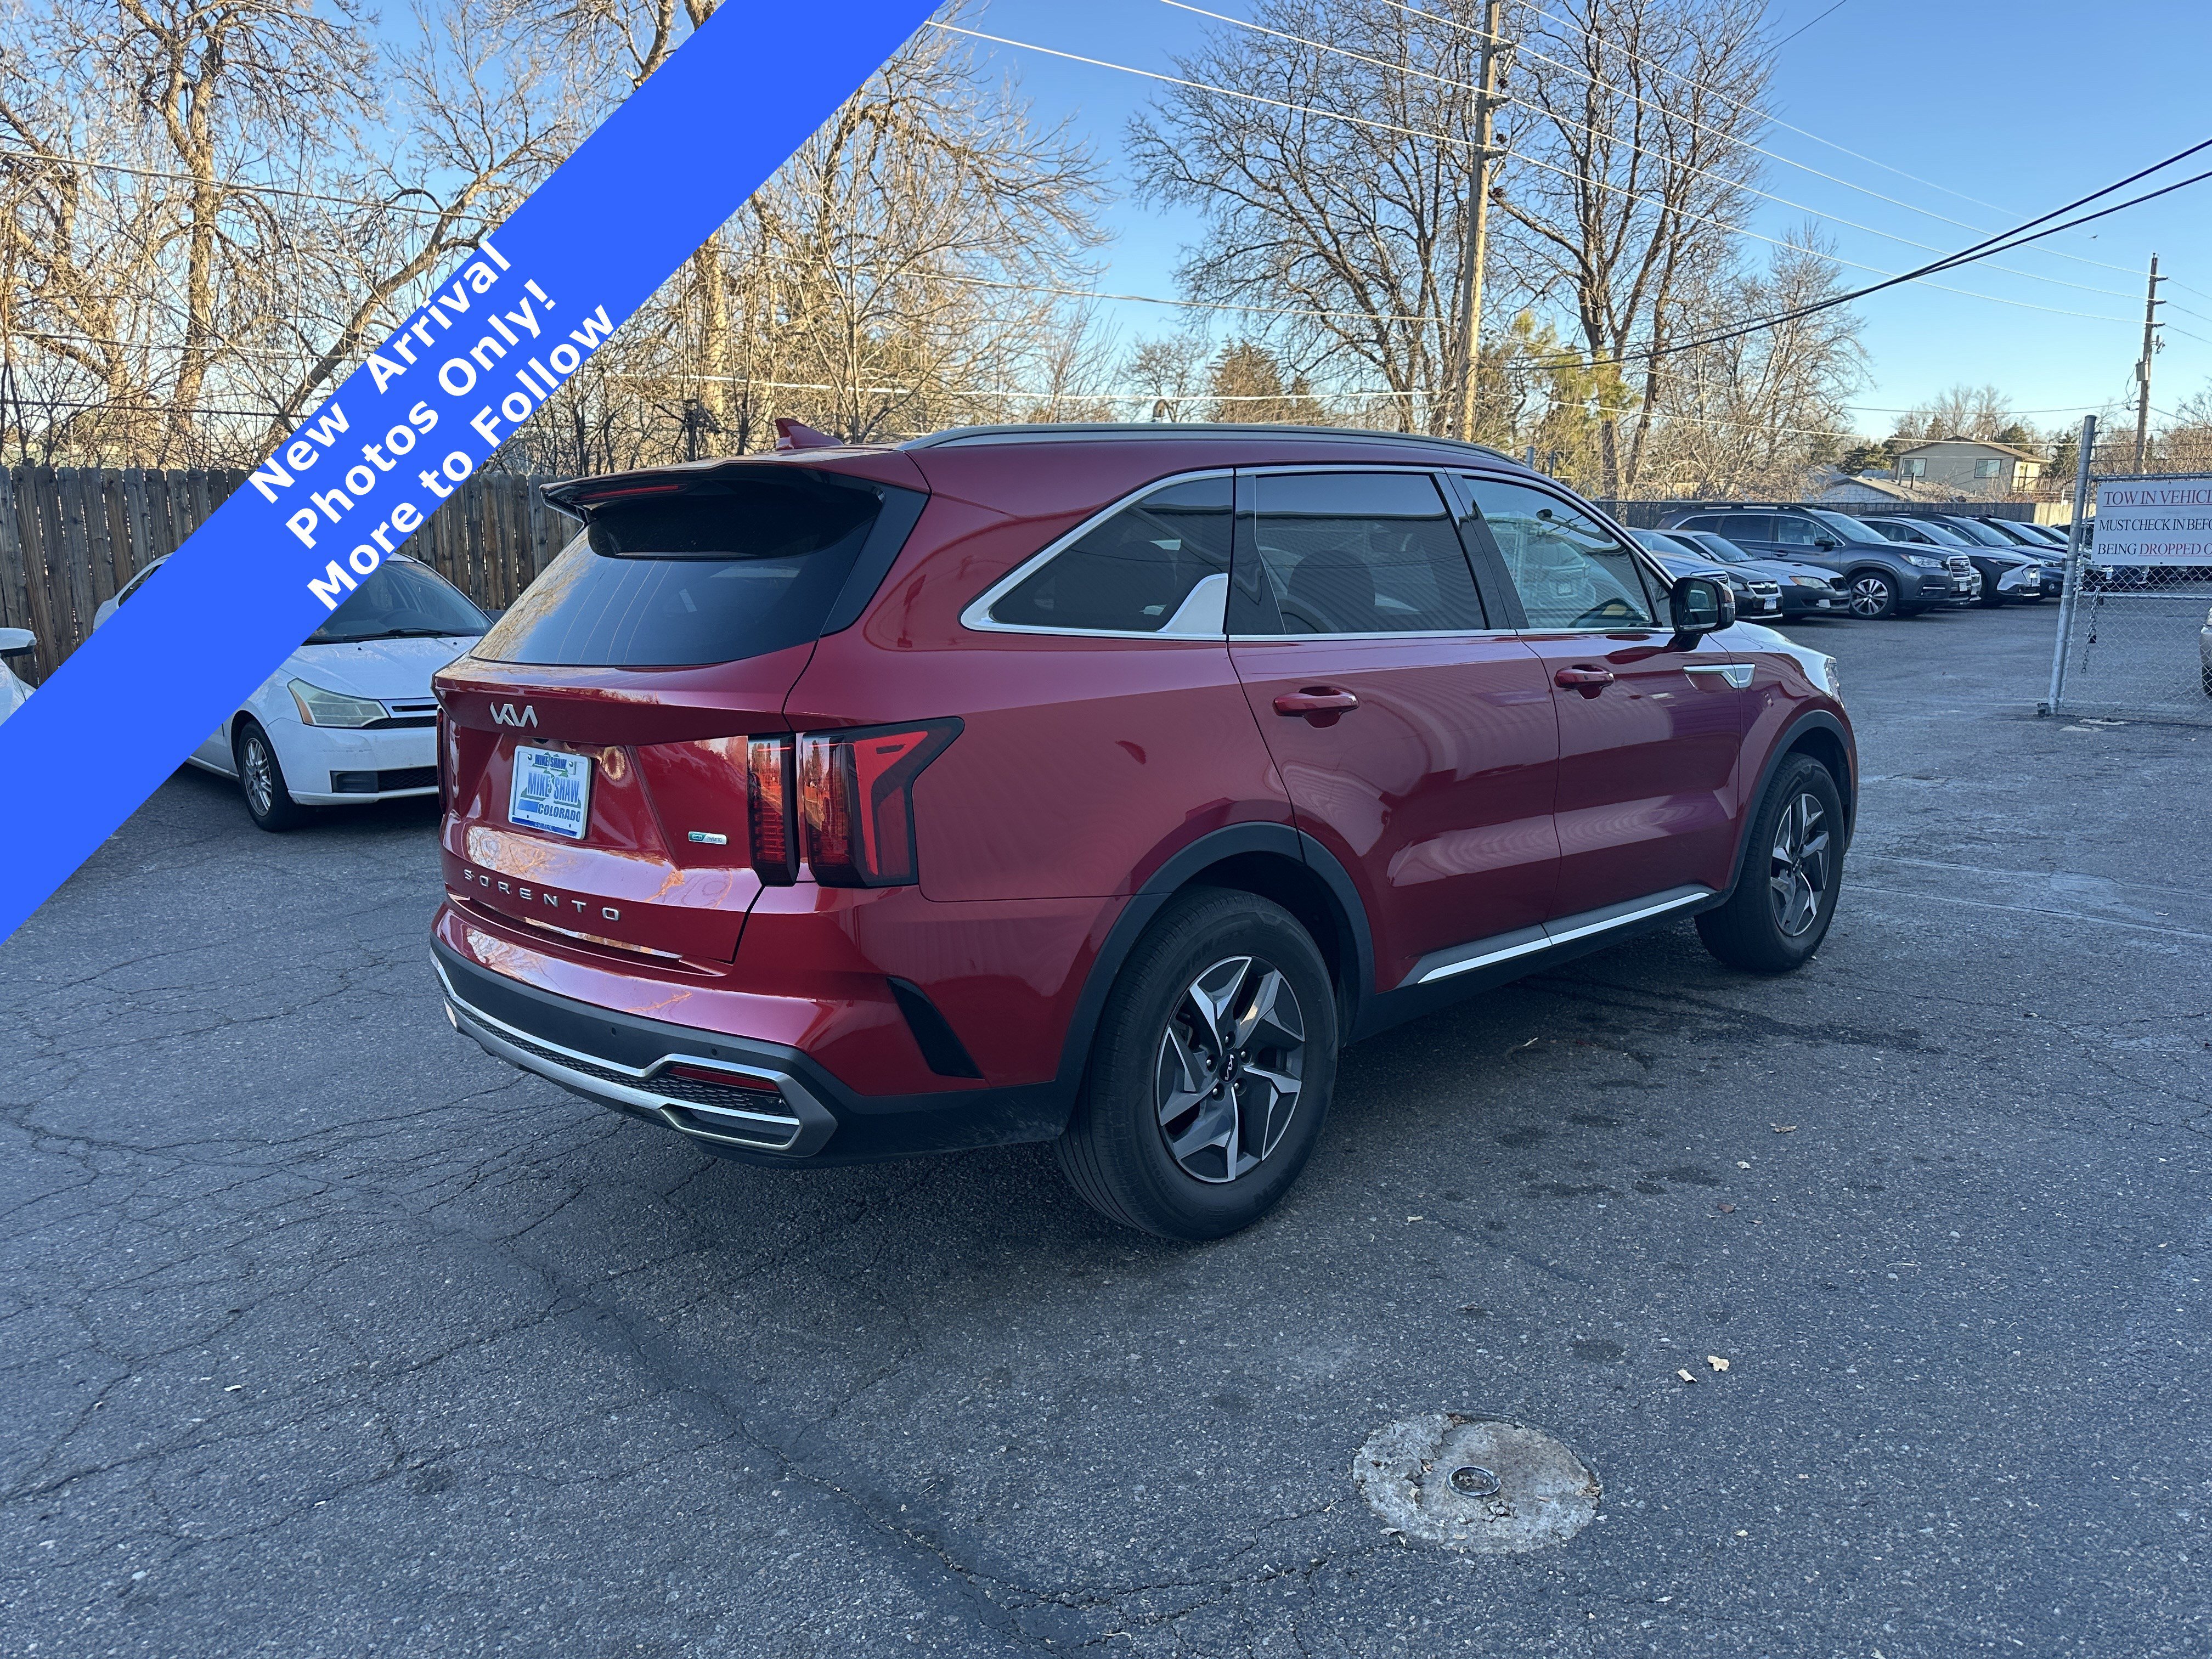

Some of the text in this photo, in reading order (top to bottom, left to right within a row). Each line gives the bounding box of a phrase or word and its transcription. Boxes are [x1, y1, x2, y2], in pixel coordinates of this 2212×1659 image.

[2104, 492, 2138, 505] TOW
[2140, 491, 2157, 504] IN
[2099, 520, 2131, 531] MUST
[2131, 519, 2171, 531] CHECK
[2172, 519, 2185, 530] IN
[2097, 543, 2137, 555] BEING
[2140, 543, 2201, 555] DROPPED
[490, 702, 538, 729] KIA
[535, 754, 567, 769] MIKE SHAW
[527, 772, 579, 803] MIKE SHAW
[538, 803, 580, 822] COLORADO
[464, 868, 620, 921] SORENTO
